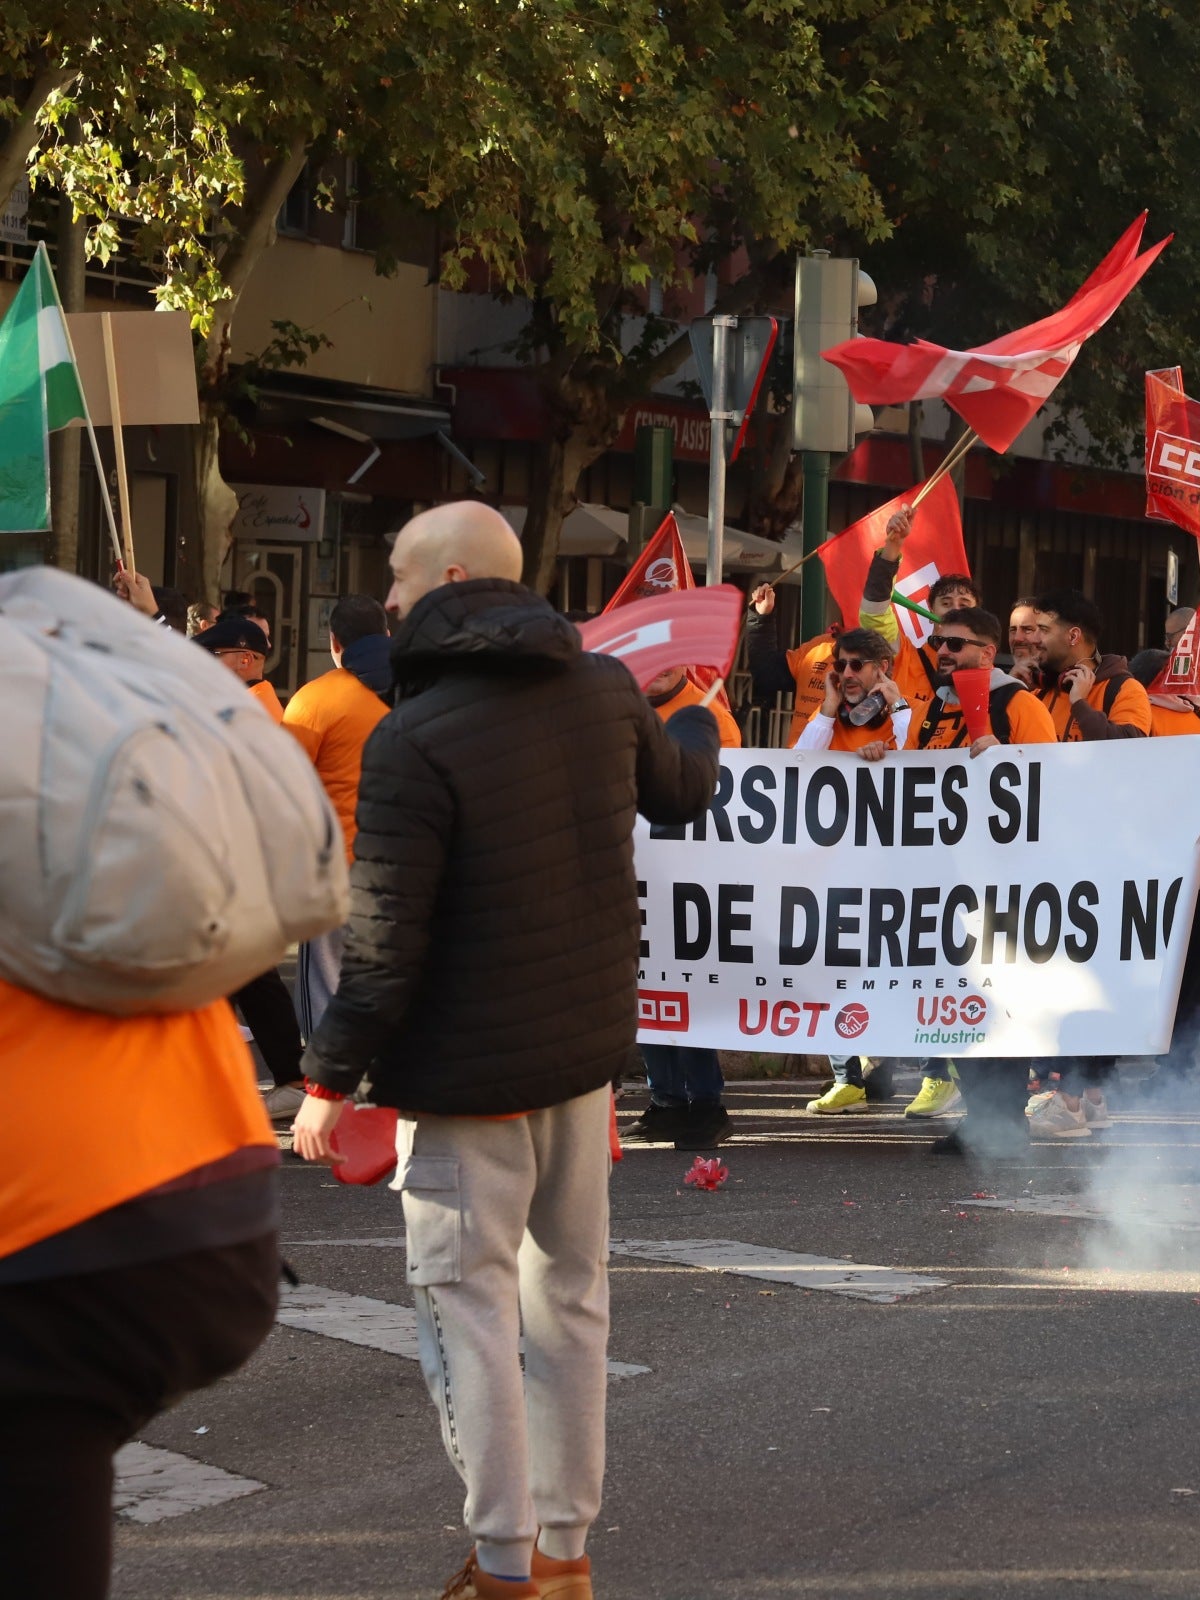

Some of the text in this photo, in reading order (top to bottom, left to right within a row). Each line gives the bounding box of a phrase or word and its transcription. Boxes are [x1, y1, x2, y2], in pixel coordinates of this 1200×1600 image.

[650, 761, 1041, 847] RSIONES SI
[673, 882, 754, 963] DE
[779, 880, 1099, 967] DERECHOS
[756, 976, 793, 987] DE
[836, 978, 992, 990] EMPRESA
[739, 998, 830, 1037] UGT
[917, 995, 987, 1025] USO
[914, 1028, 985, 1044] industria
